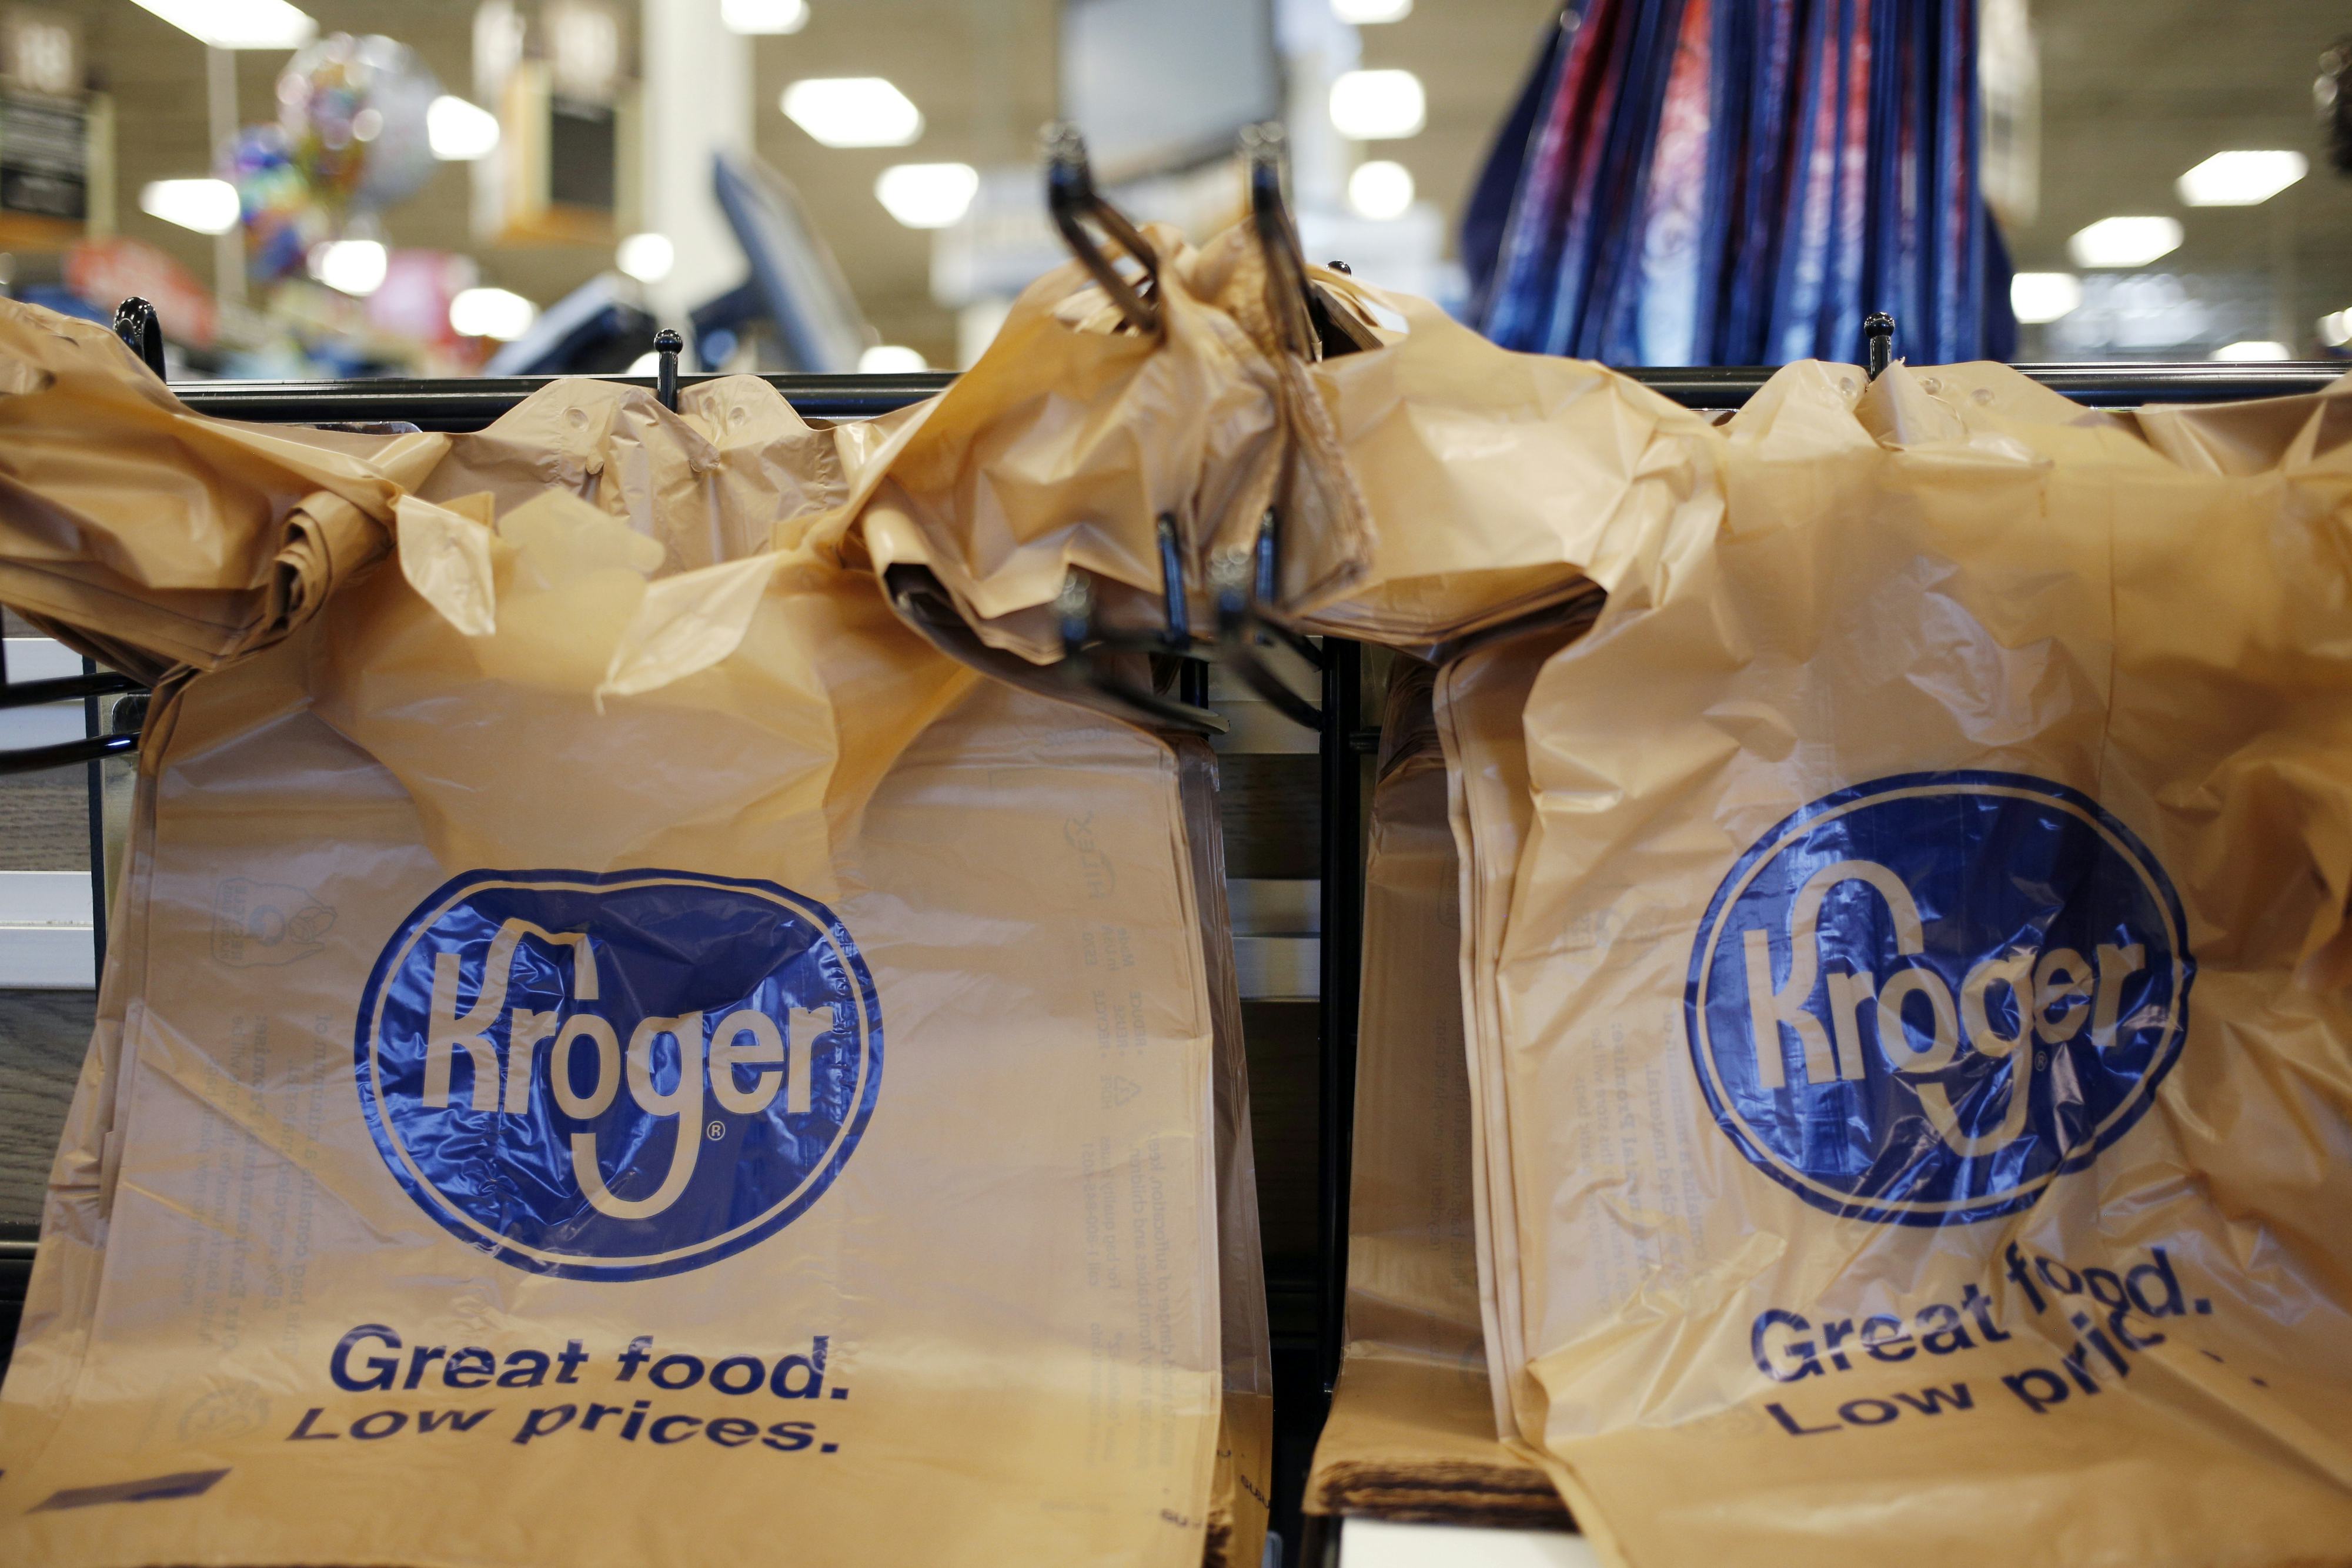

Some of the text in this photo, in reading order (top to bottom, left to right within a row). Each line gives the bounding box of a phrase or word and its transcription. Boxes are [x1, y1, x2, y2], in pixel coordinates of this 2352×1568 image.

[1743, 859, 2145, 1158] Kroger
[421, 917, 833, 1220] Kroger
[329, 1323, 850, 1400] Great food.
[1750, 1282, 2010, 1384] Great
[285, 1399, 840, 1455] Low prices.
[1764, 1382, 1976, 1436] Low
